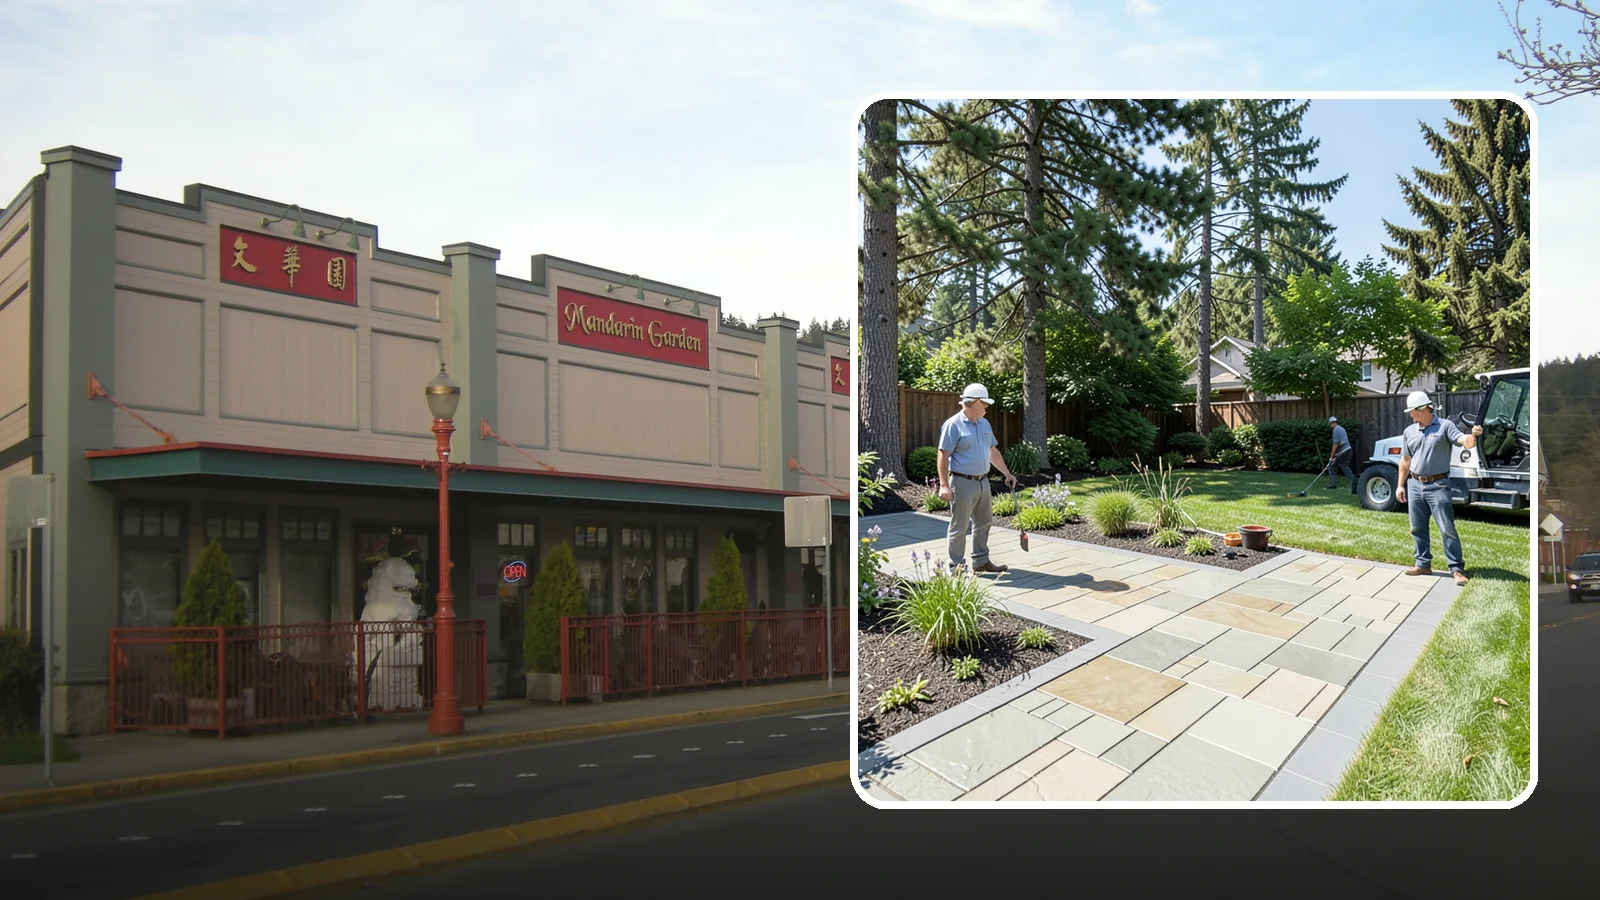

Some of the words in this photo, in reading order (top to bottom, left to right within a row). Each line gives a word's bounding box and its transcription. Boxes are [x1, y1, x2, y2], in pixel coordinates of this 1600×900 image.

[231, 236, 347, 291] 文華園
[564, 302, 644, 341] Mandarin
[648, 320, 701, 352] Garden
[503, 565, 527, 578] OPEN
